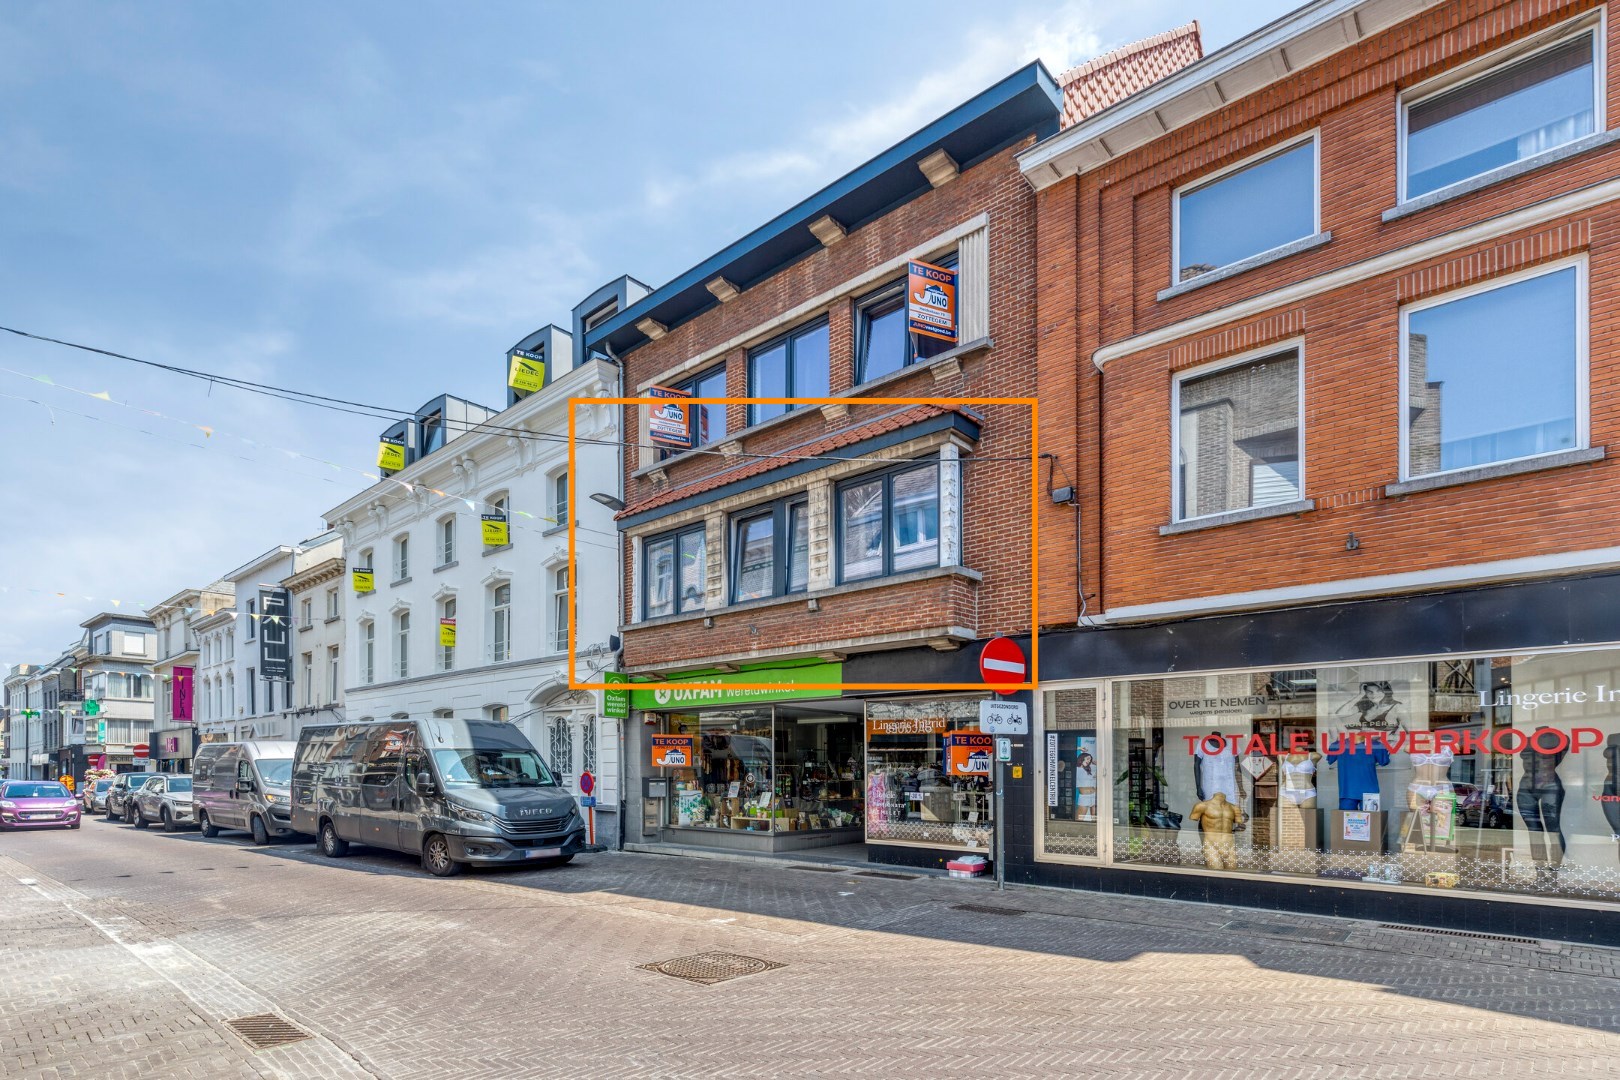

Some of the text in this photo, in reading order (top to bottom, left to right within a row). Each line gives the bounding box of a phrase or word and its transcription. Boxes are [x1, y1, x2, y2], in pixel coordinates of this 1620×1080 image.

[913, 265, 952, 283] TE KOOP
[914, 284, 948, 308] JUNO
[918, 313, 948, 326] ZOTTEGEM
[525, 352, 543, 360] KOOP
[654, 404, 683, 421] JUNO
[673, 680, 722, 701] OXFAM
[1168, 696, 1266, 710] OVER TE NEMEN
[1479, 688, 1588, 710] Lingerie
[955, 736, 967, 745] TE
[1183, 727, 1604, 756] TOTALE UITVERKOOP
[656, 749, 685, 765] JUNO
[1592, 795, 1620, 803] van
[519, 808, 553, 816] IVECO
